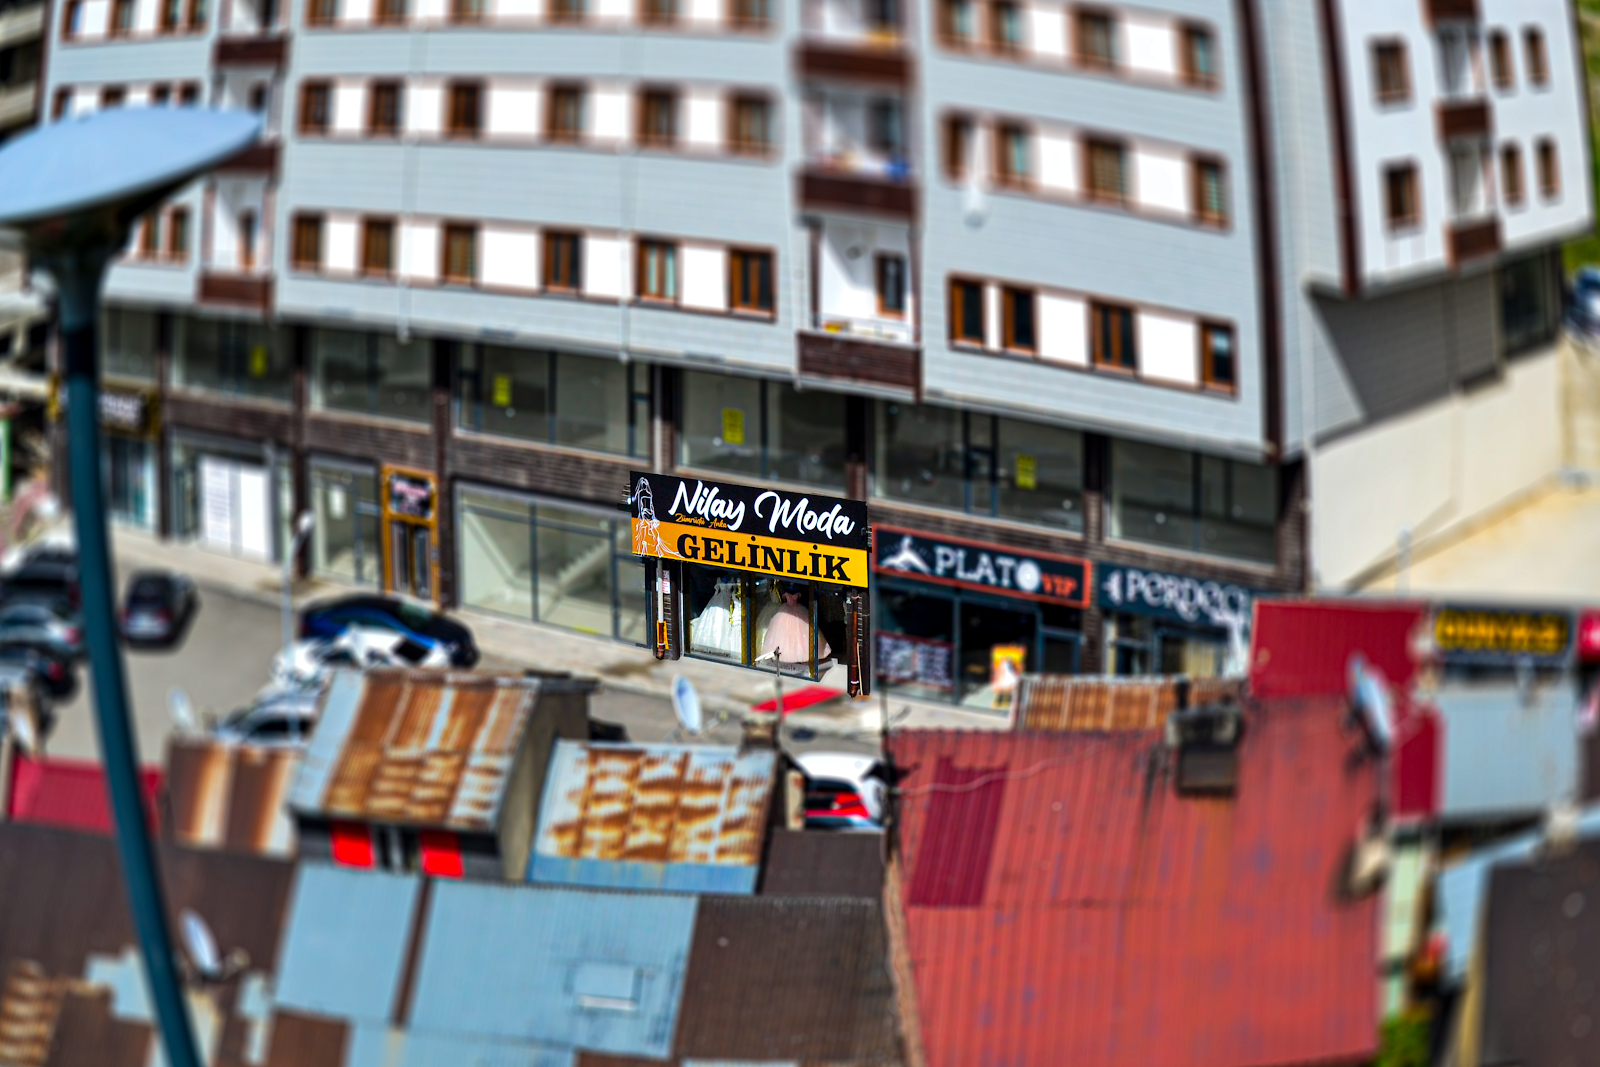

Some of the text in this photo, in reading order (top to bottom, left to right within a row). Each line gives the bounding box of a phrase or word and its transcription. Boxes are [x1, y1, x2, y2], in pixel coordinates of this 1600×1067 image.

[668, 480, 855, 539] Nilay Moda
[677, 534, 850, 581] GELİNLİK
